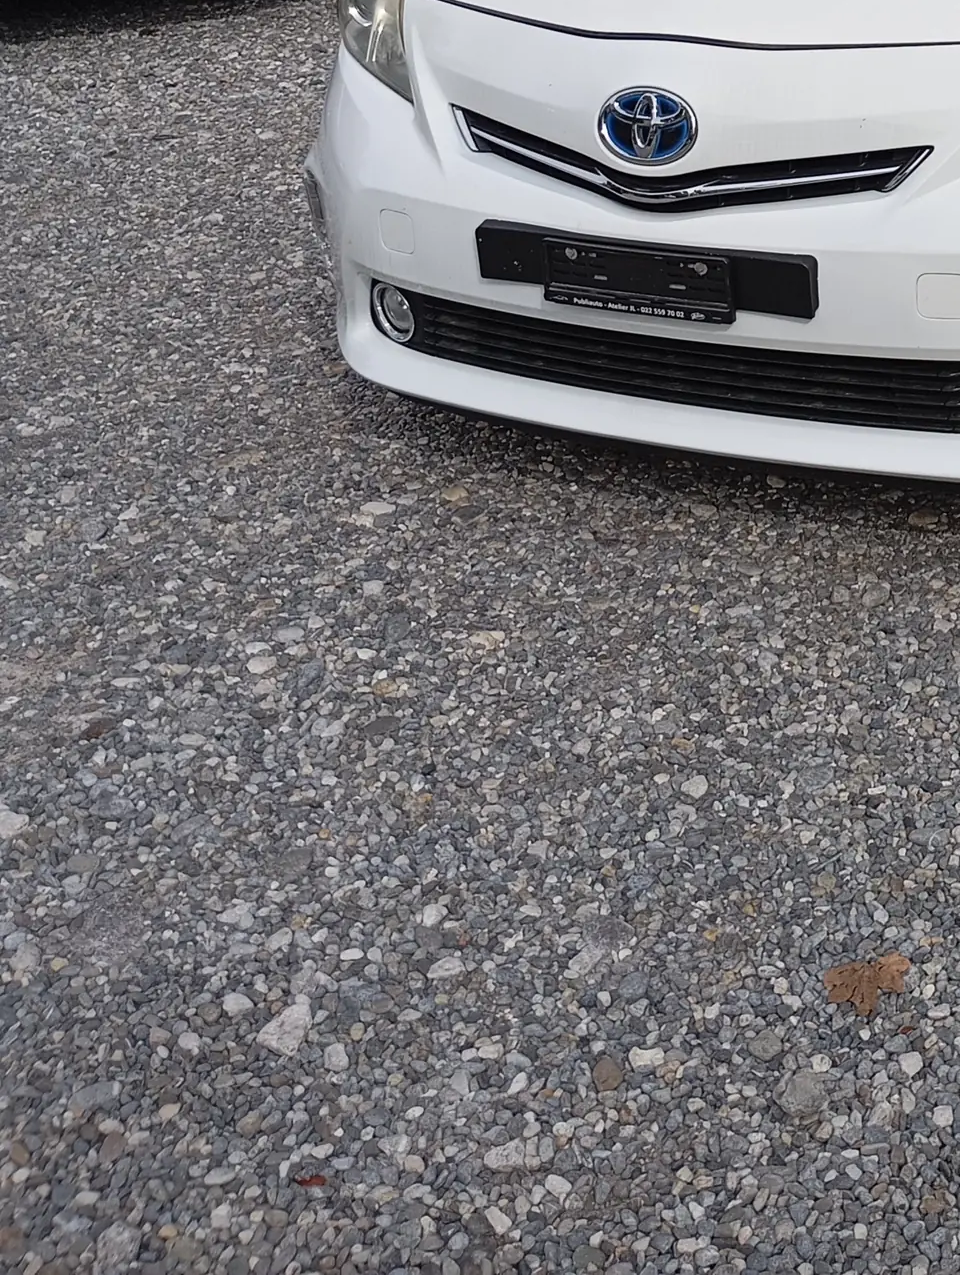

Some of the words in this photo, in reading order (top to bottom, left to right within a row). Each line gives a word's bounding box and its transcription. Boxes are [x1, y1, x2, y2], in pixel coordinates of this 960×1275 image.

[607, 302, 628, 311] Atelier
[641, 306, 652, 314] 022
[653, 308, 665, 316] 559
[667, 309, 675, 317] 70
